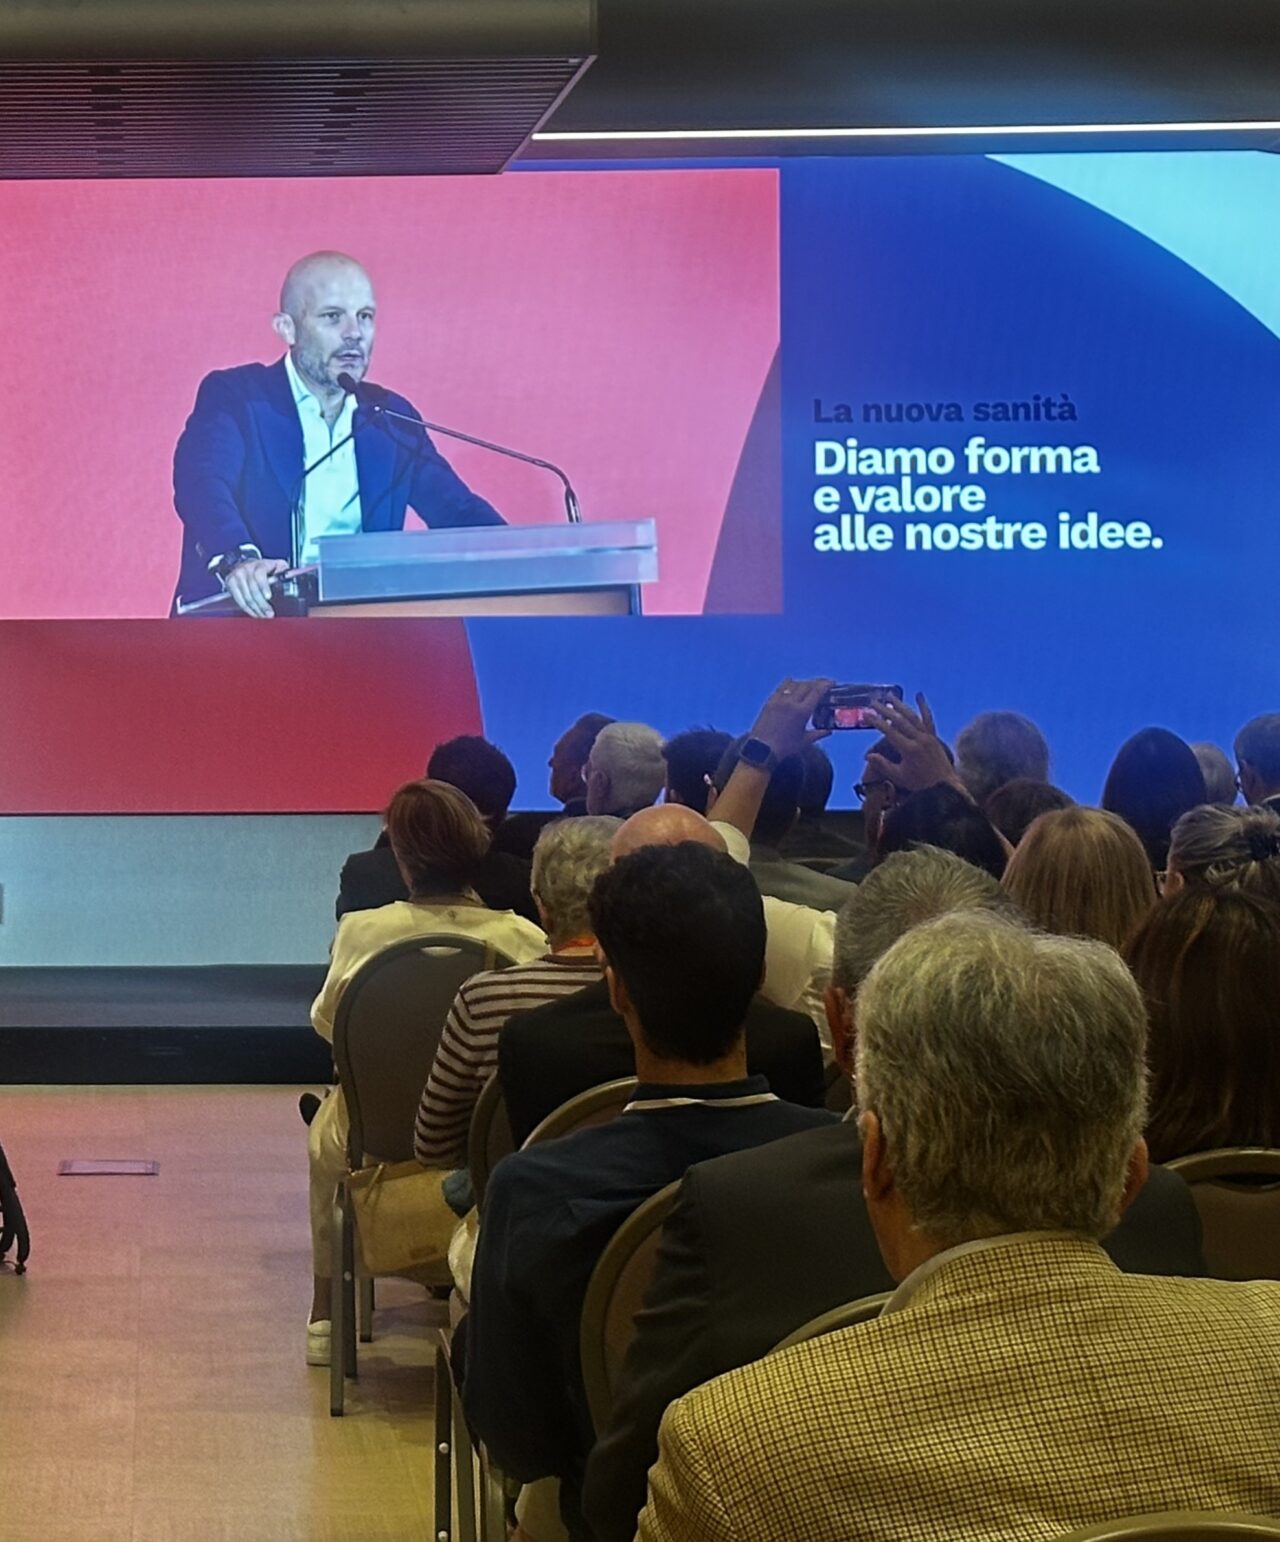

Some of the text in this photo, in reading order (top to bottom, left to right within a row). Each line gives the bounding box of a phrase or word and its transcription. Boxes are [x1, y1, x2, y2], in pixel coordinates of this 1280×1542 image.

[813, 393, 1078, 423] La nuova sanità
[814, 436, 1100, 475] Diamo forma
[813, 475, 986, 513] e valore
[813, 511, 1164, 551] alle nostre idee.
